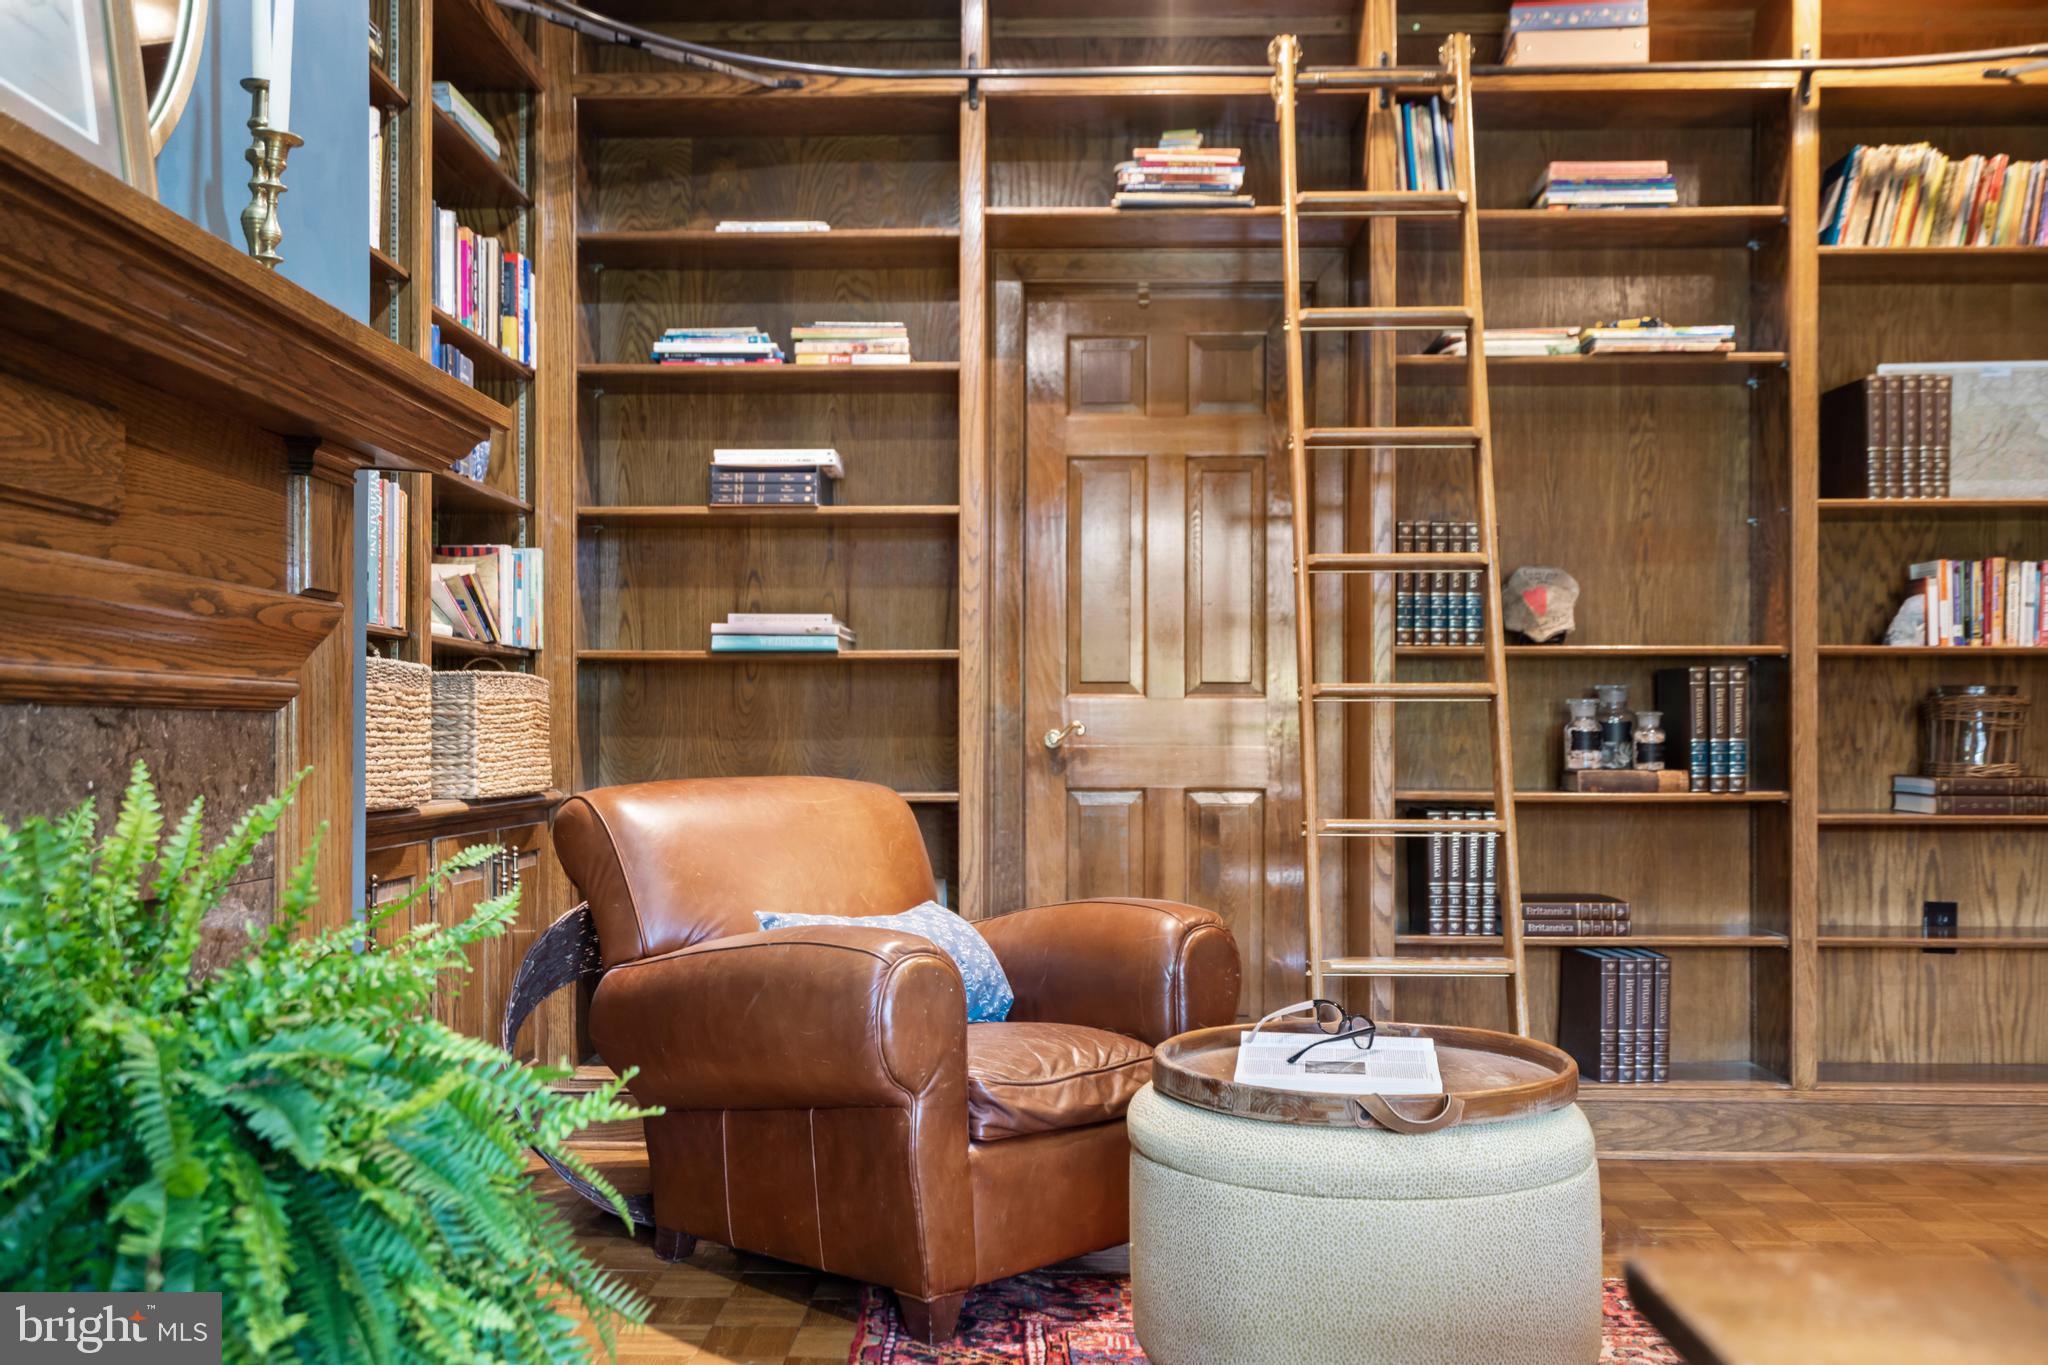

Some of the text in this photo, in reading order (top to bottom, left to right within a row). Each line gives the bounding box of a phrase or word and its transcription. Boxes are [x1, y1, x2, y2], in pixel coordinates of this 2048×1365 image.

[369, 470, 381, 557] NTERTAINING
[1695, 687, 1705, 734] Britannica
[1714, 688, 1725, 735] Britannica
[1733, 687, 1744, 734] Britannica
[1526, 906, 1573, 916] Britannica
[1527, 923, 1574, 933] Britannica
[1606, 978, 1616, 1024] Britannica
[1625, 979, 1635, 1025] Britannica
[1642, 978, 1651, 1024] Britannica
[1659, 978, 1669, 1024] Britannica
